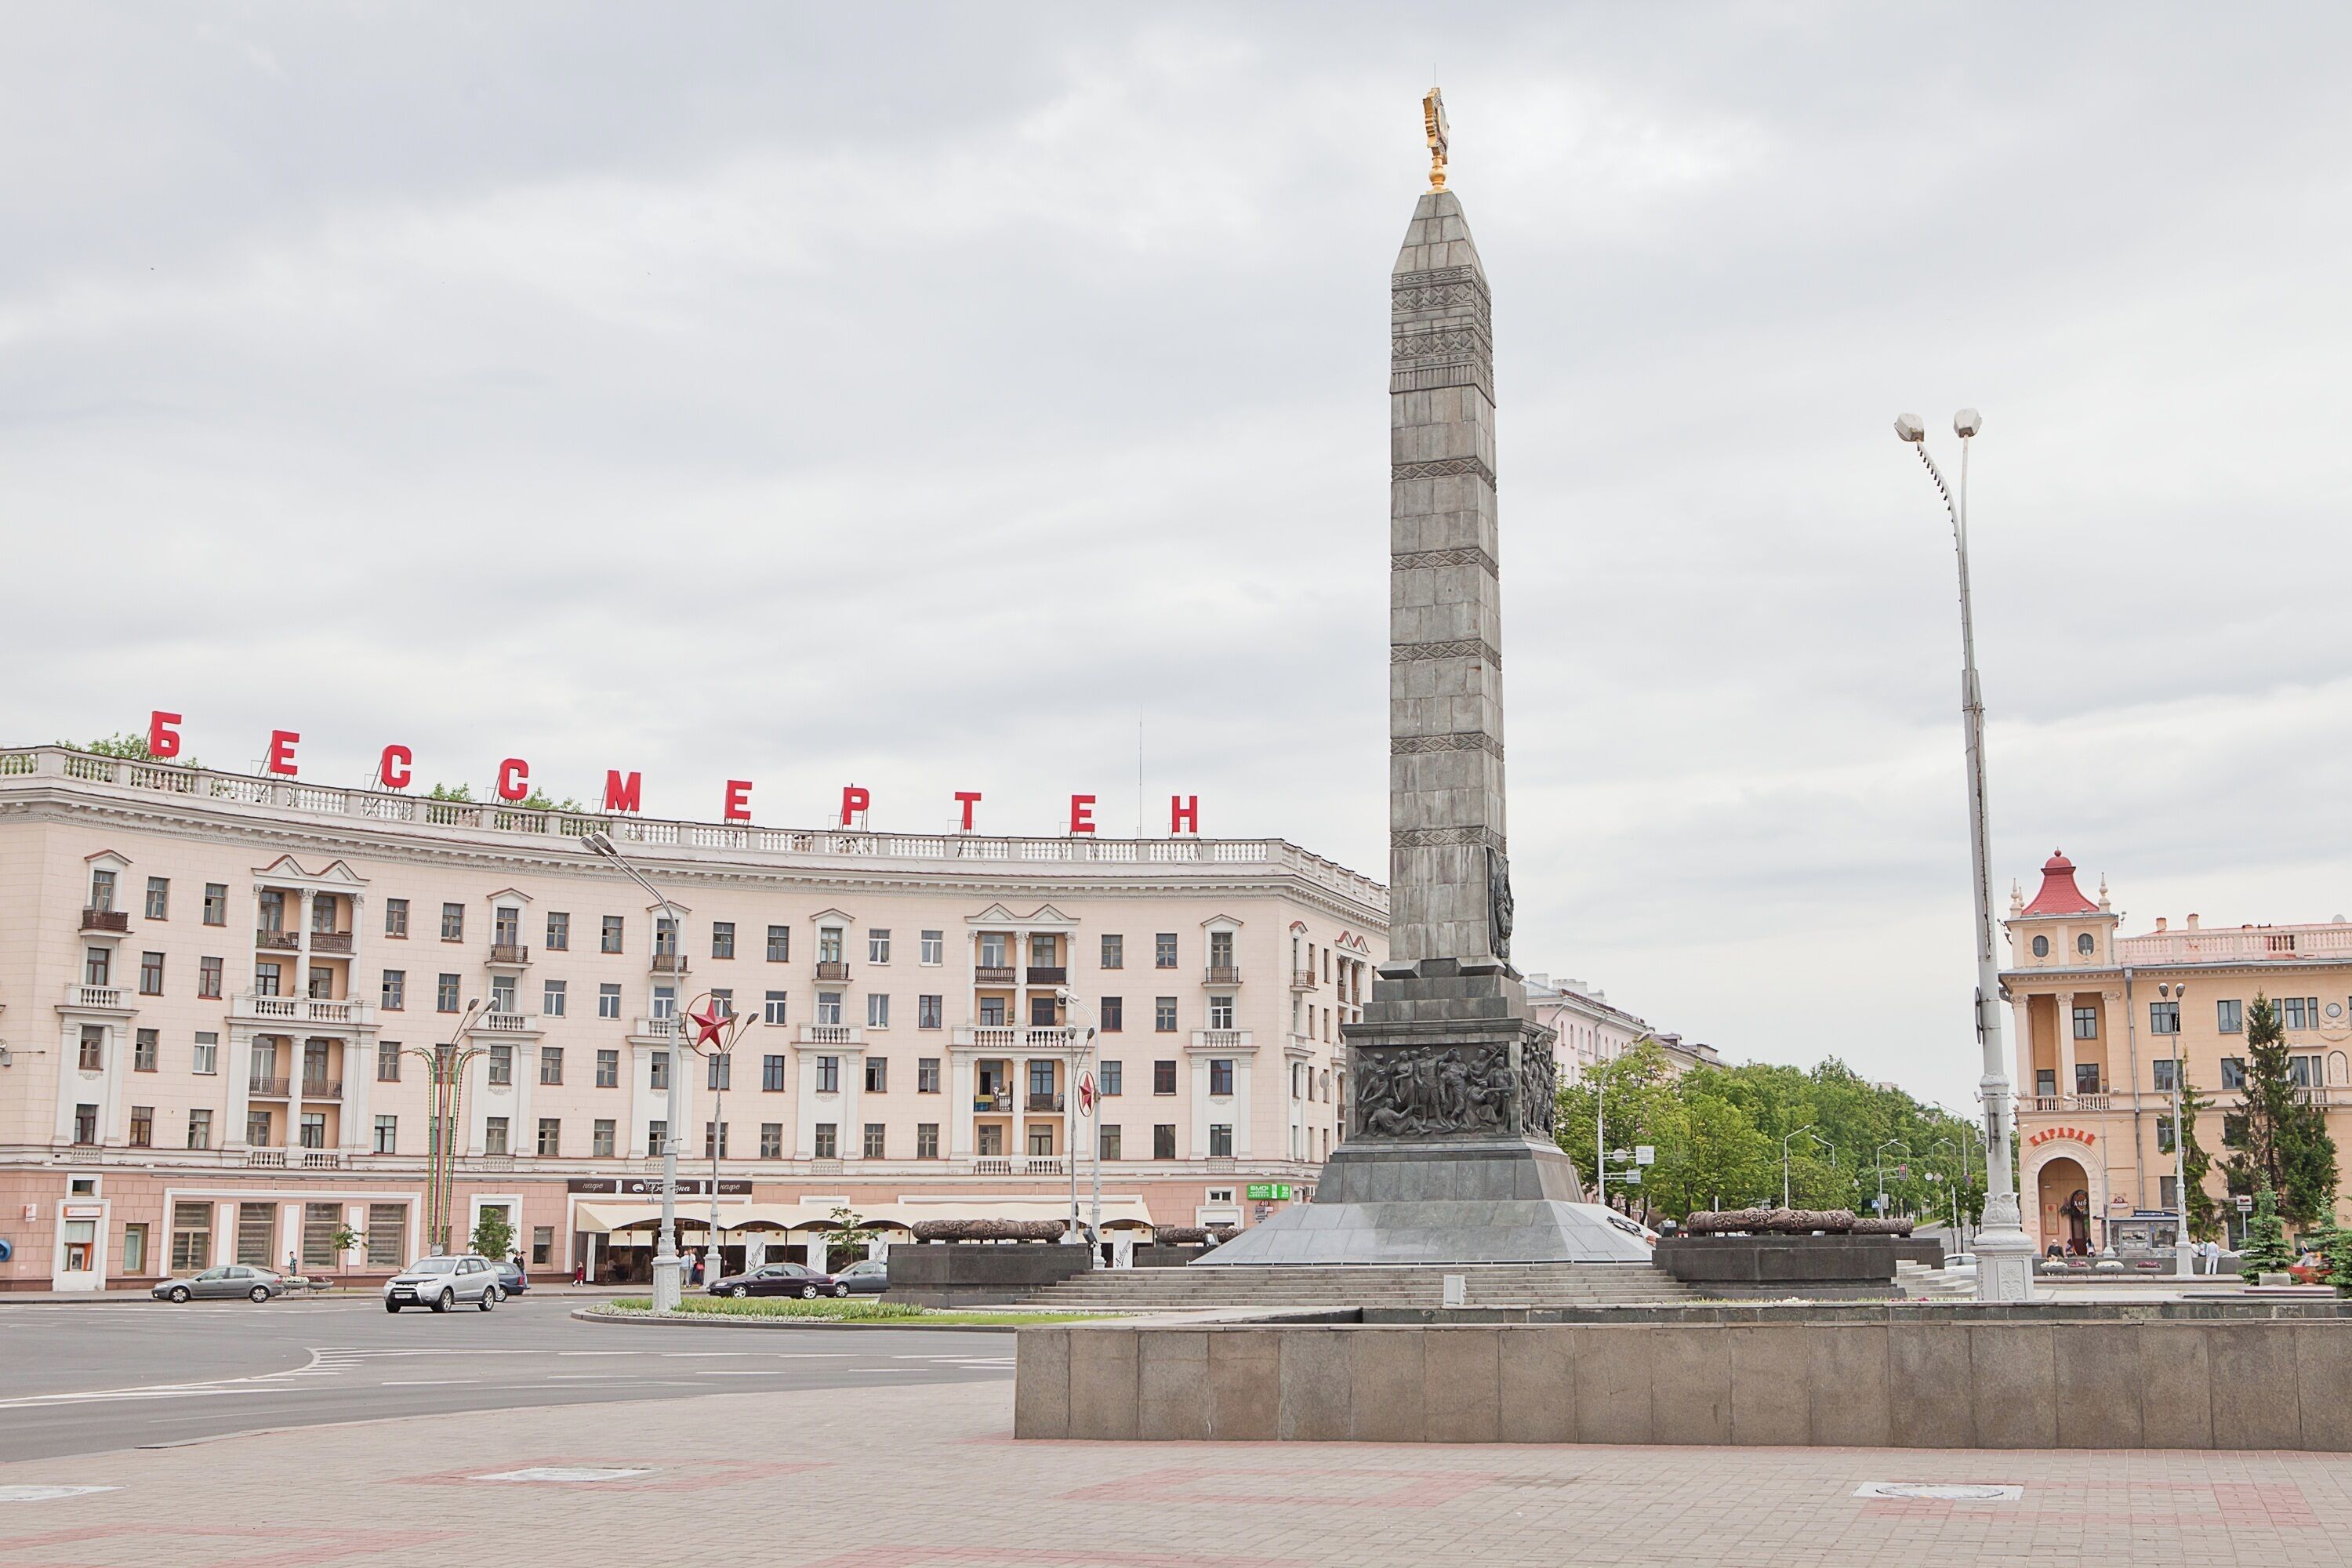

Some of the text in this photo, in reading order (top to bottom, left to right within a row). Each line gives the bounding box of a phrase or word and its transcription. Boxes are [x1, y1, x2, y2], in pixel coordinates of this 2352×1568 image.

[150, 710, 1198, 833] БЕССМЕРТЕН
[2029, 1127, 2096, 1146] КАРАВАЙ
[583, 1182, 604, 1192] кафе
[719, 1183, 740, 1192] кафе
